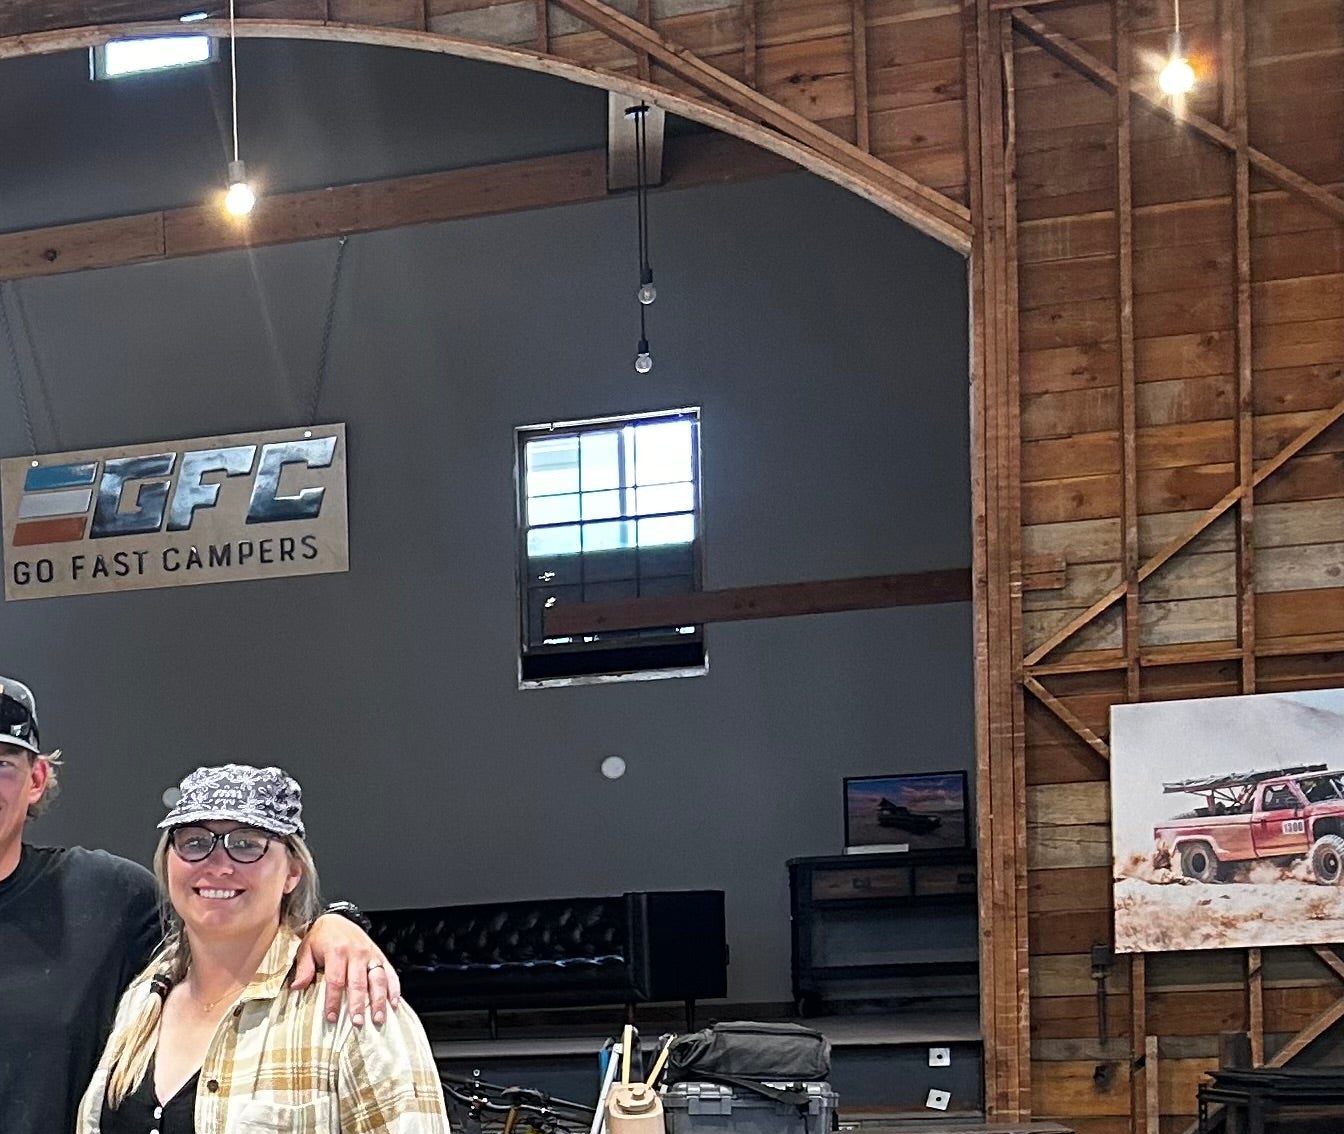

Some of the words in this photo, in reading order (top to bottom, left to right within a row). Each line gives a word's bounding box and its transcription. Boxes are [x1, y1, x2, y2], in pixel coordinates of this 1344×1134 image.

[89, 436, 338, 540] GFC
[13, 558, 54, 586] GO
[71, 550, 149, 581] FAST
[162, 535, 319, 573] CAMPERS
